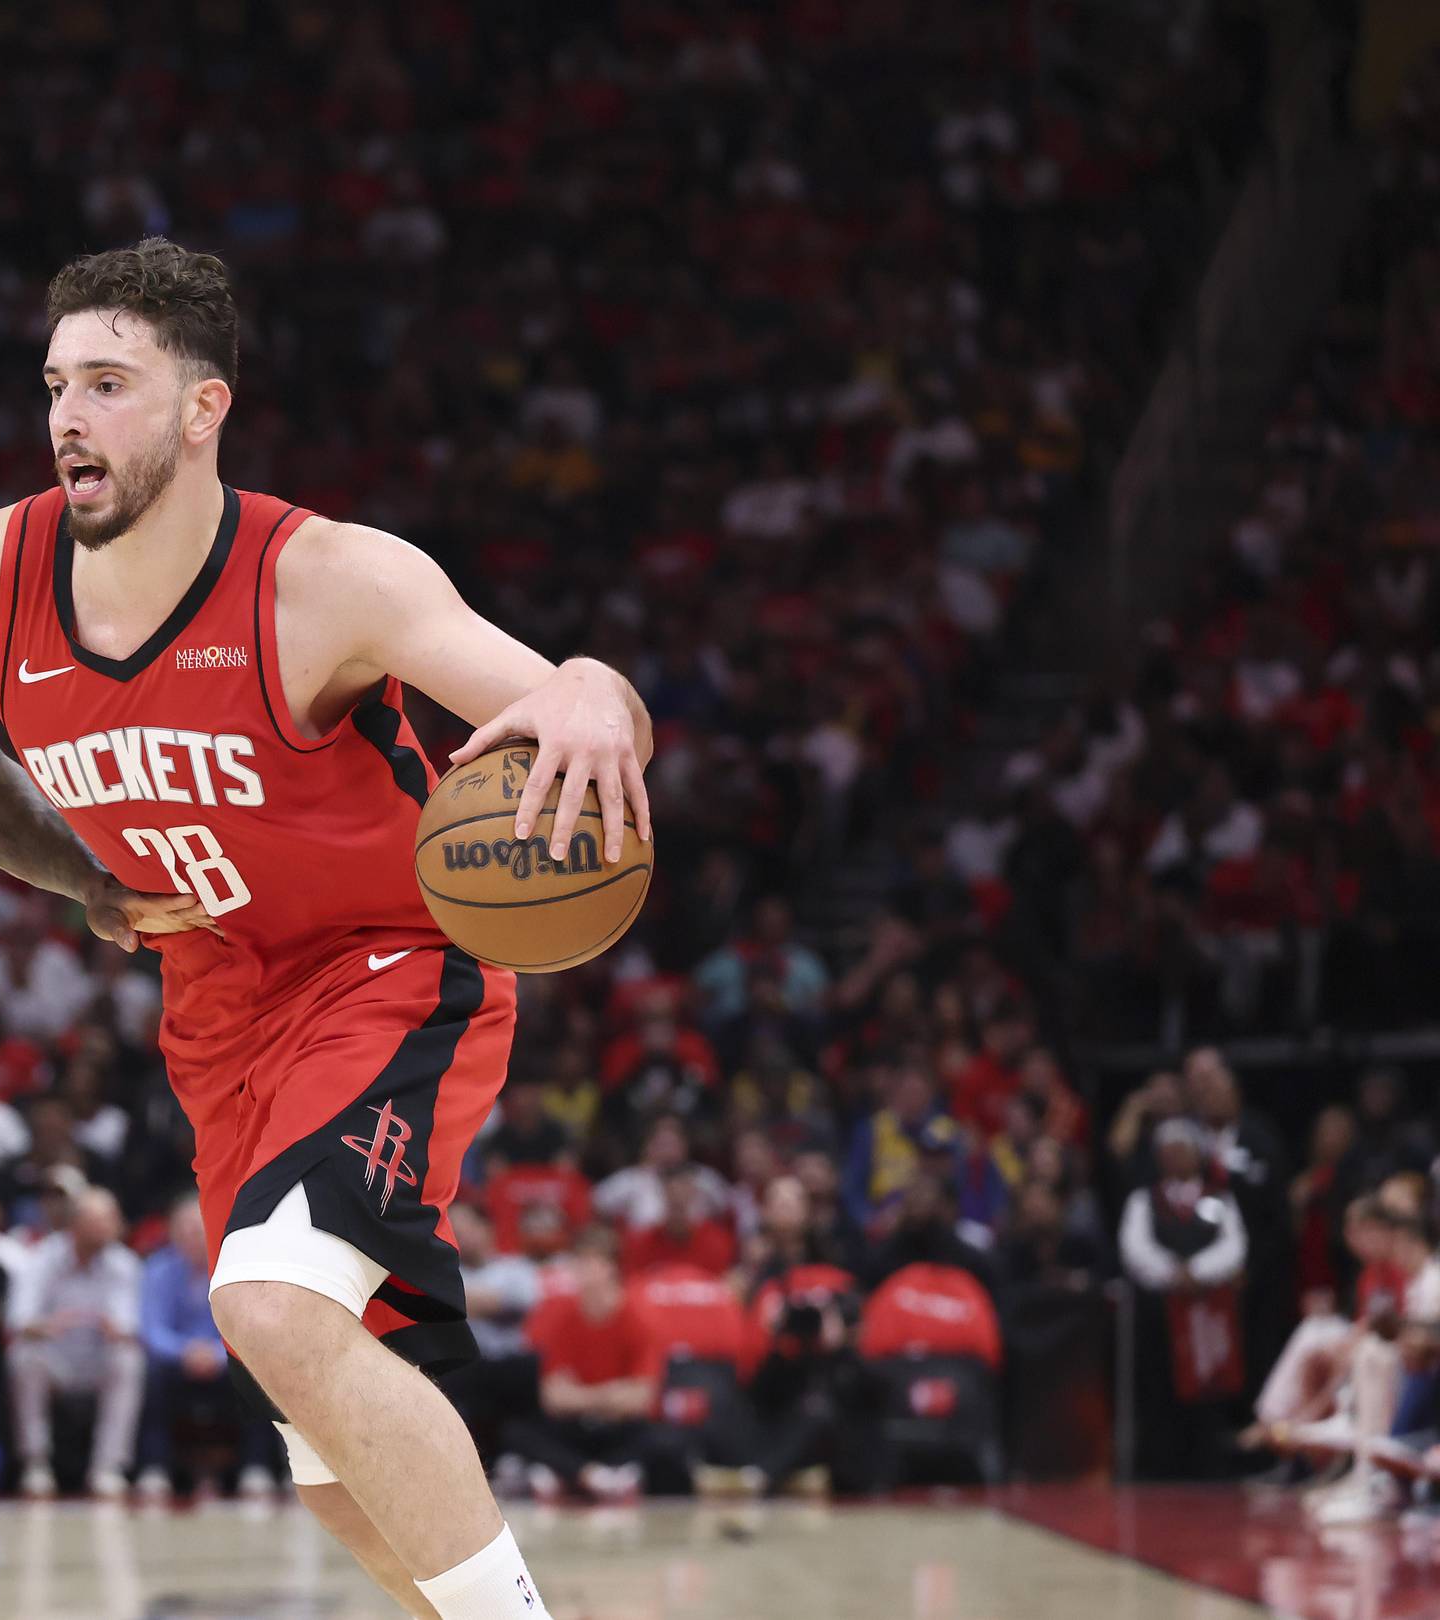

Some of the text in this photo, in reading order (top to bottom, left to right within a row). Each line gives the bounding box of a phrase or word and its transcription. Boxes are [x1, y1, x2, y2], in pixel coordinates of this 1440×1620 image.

[176, 646, 248, 661] MEMORIAL
[176, 656, 247, 669] HERMANN
[22, 726, 266, 809] ROCKETS
[442, 829, 602, 880] Wilson
